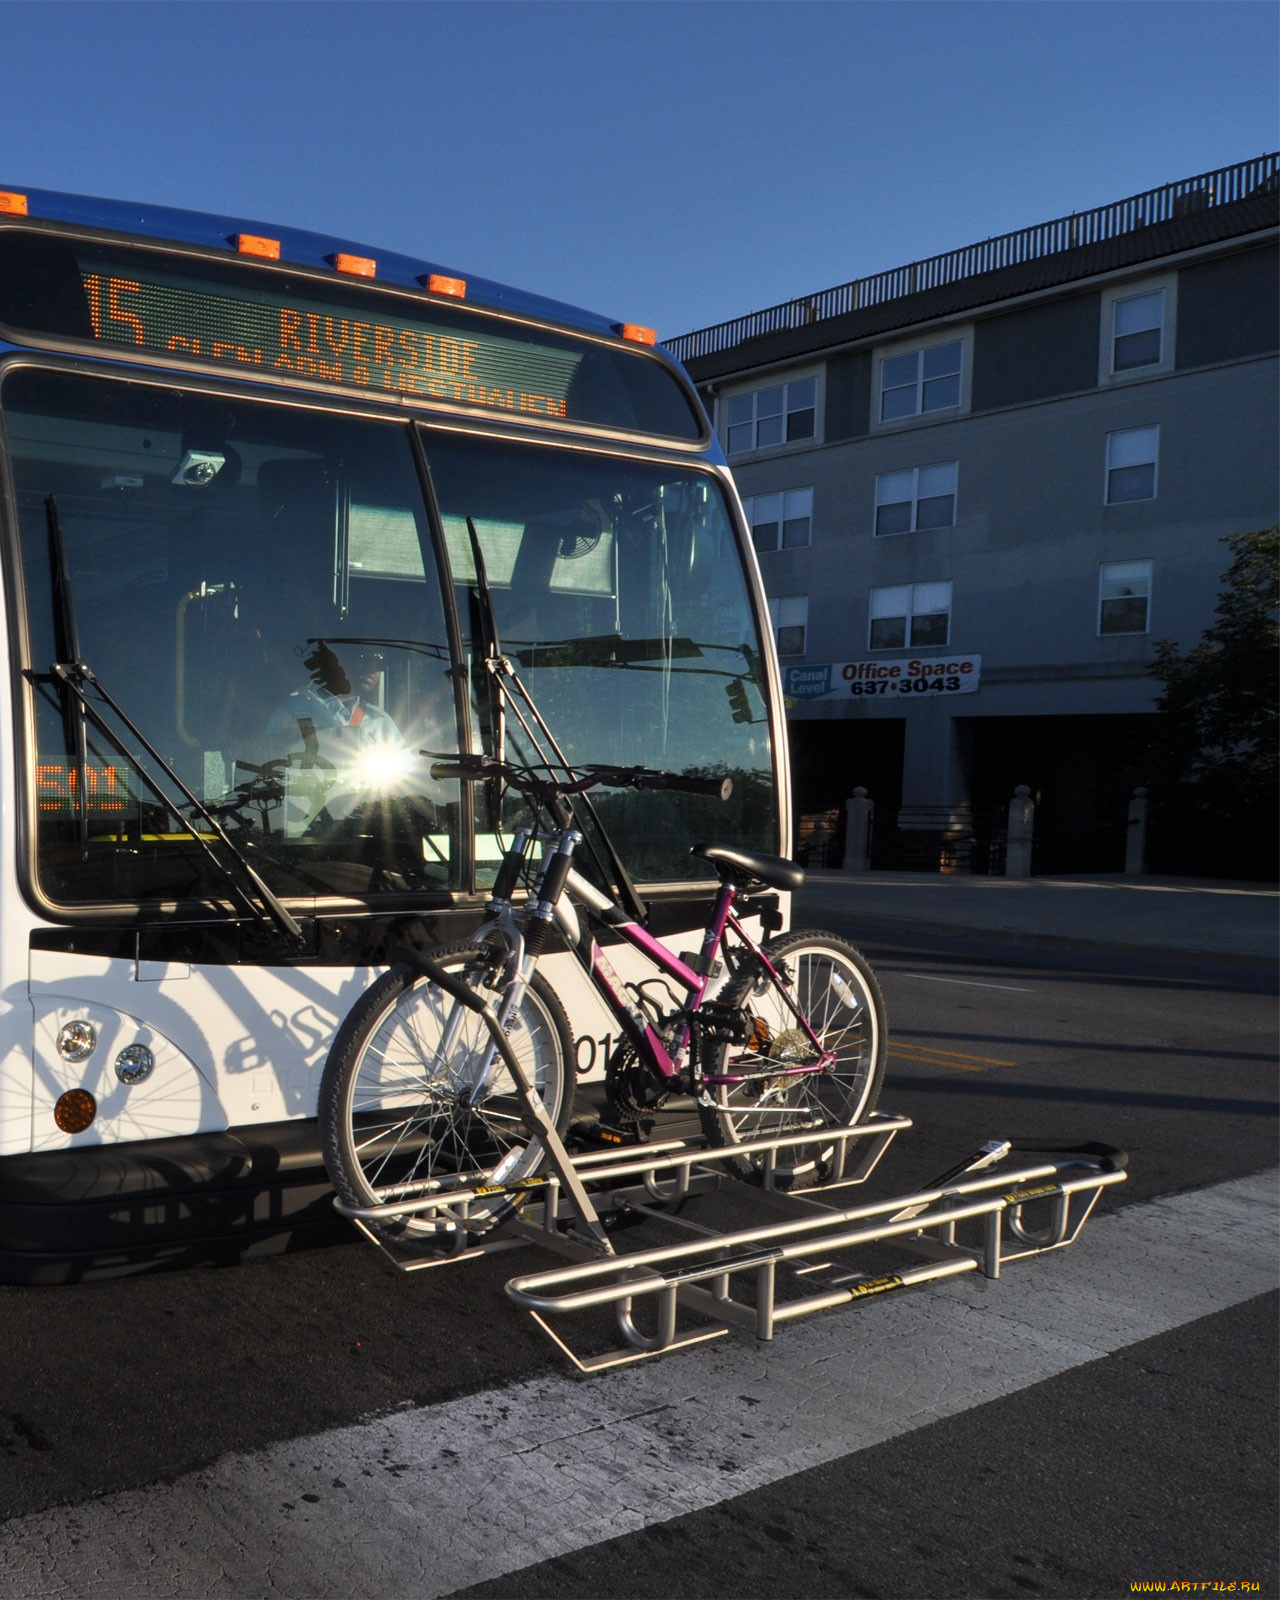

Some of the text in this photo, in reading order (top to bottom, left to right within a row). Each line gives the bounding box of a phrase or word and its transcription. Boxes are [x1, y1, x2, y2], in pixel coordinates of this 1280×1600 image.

[83, 273, 144, 345] 15
[280, 308, 479, 380] RIVERSIDE
[789, 668, 828, 682] Canal
[842, 660, 974, 681] Office Space
[790, 682, 825, 694] Level
